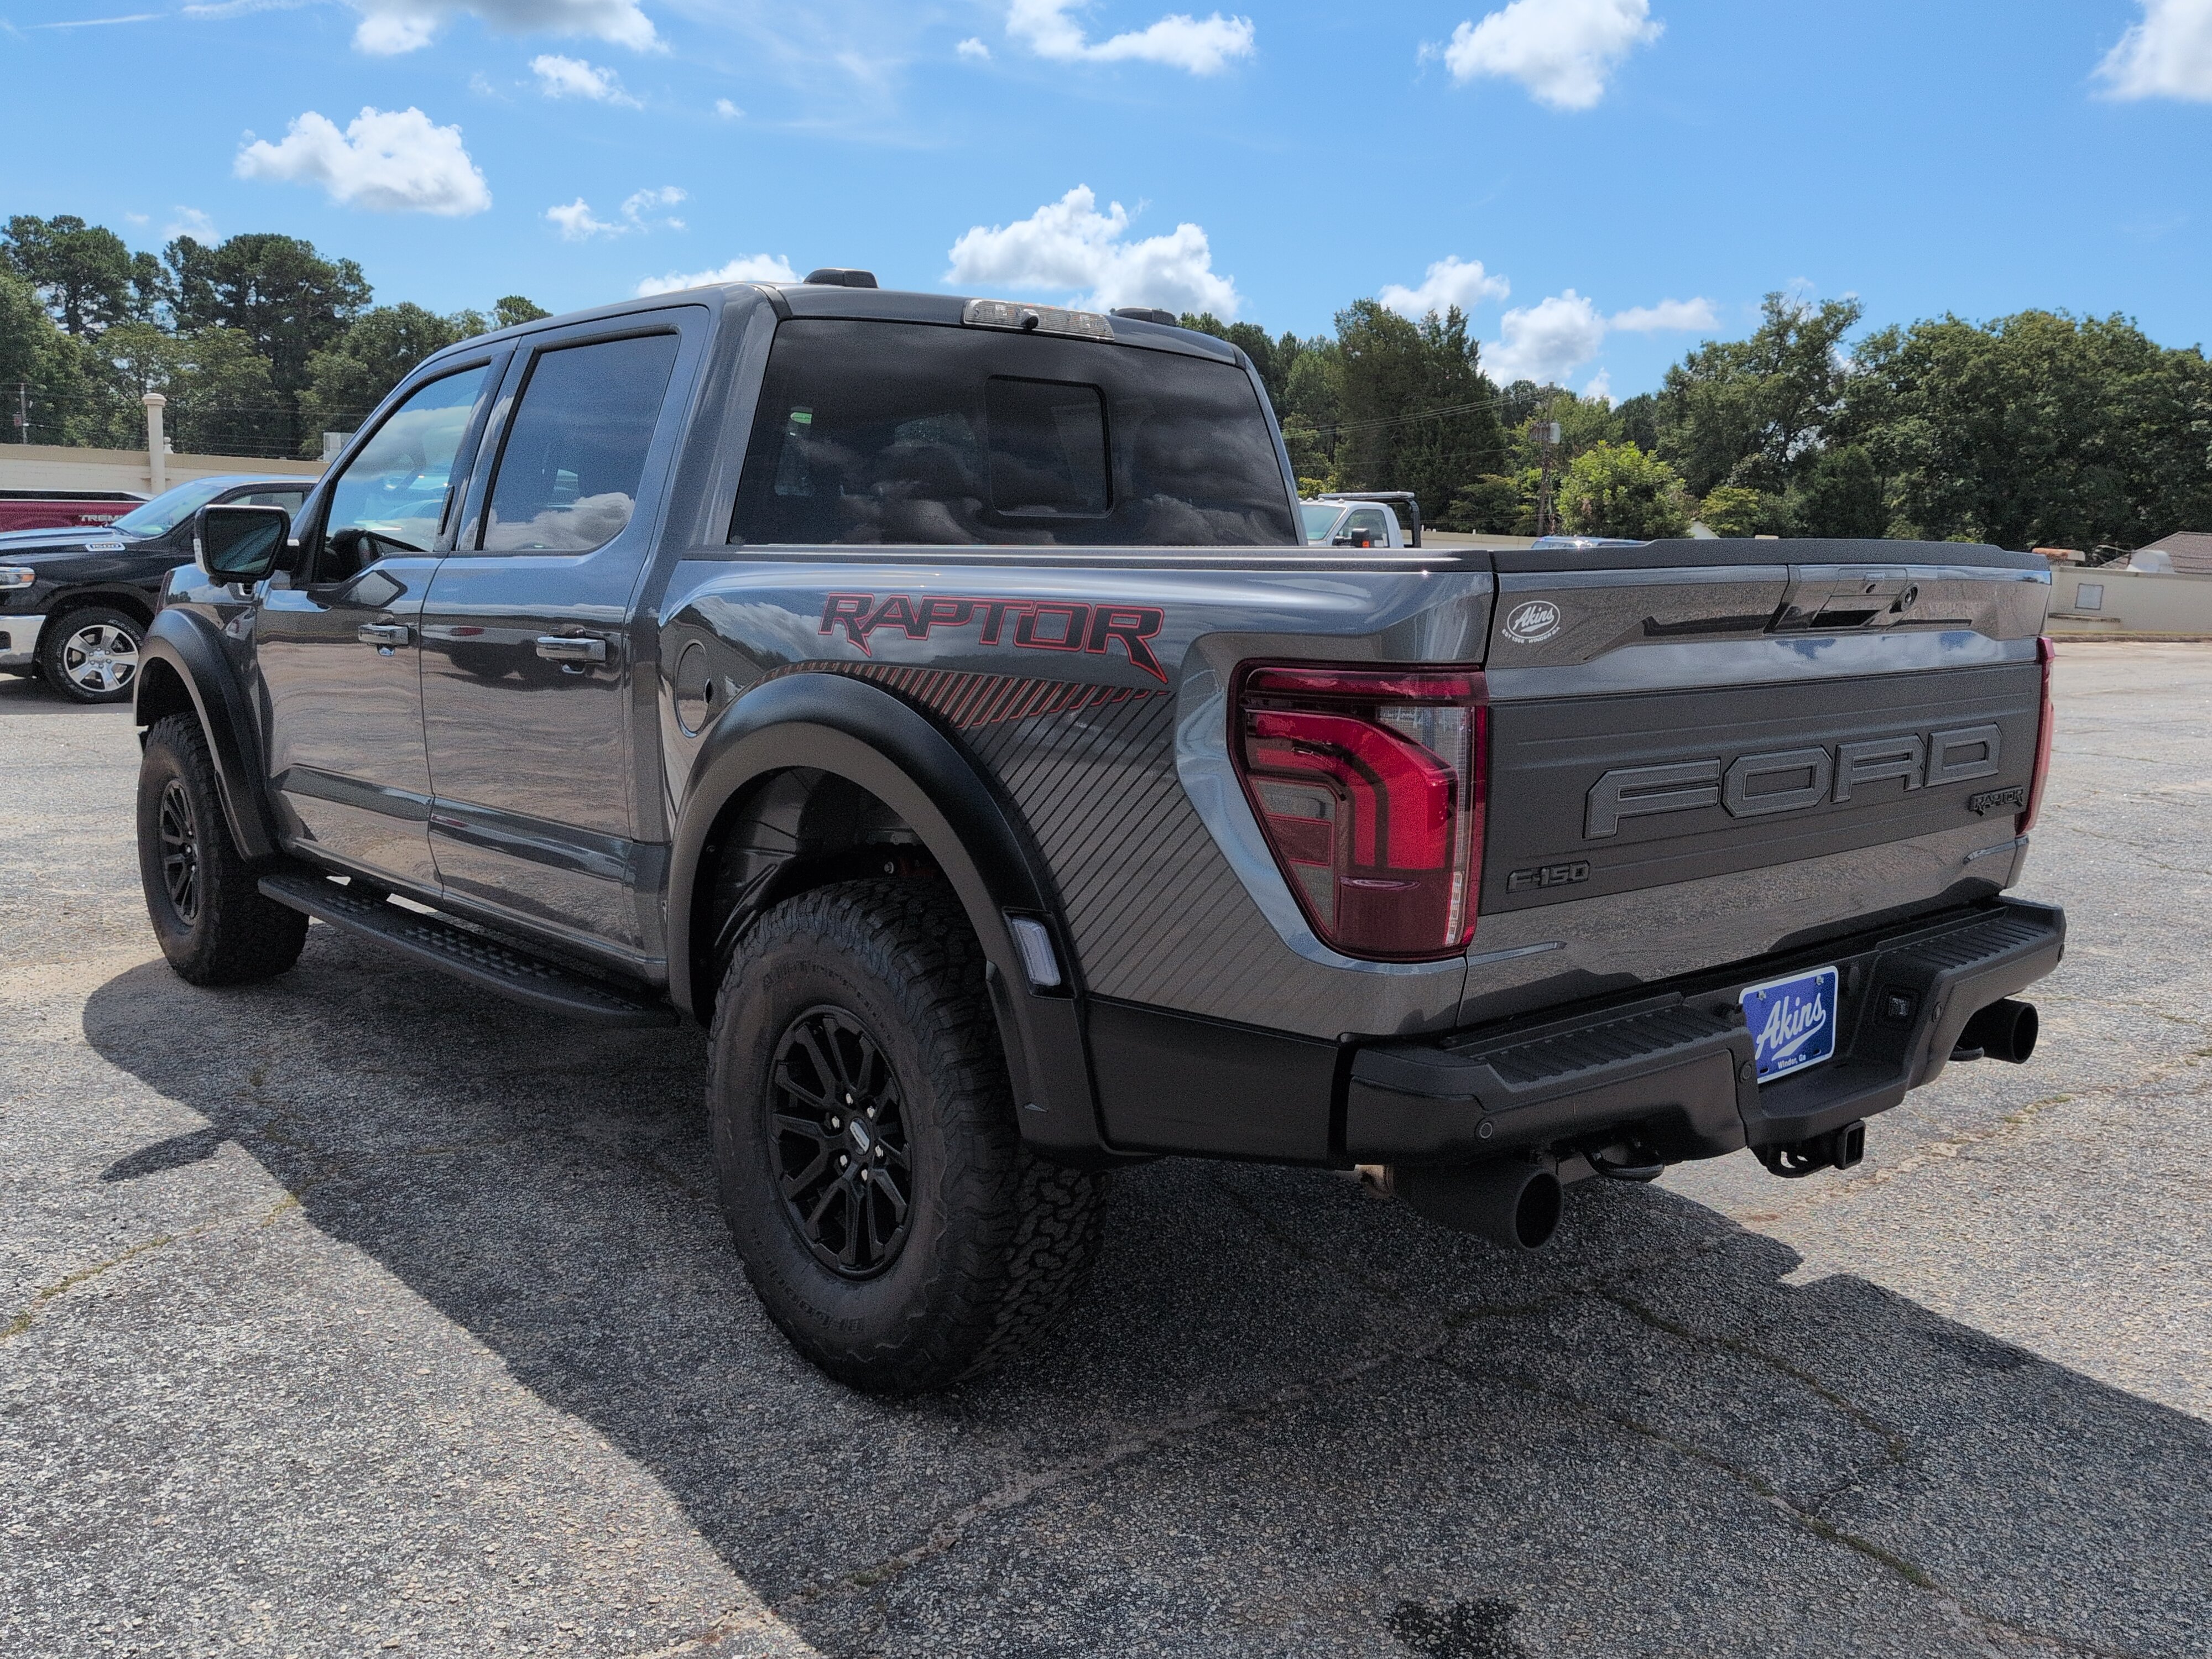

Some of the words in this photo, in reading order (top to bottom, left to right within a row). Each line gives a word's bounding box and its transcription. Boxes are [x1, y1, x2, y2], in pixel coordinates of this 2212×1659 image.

[1512, 606, 1554, 632] Akins
[1528, 633, 1552, 644] WINDER
[1552, 627, 1561, 635] GA
[818, 592, 1168, 684] RAPTOR
[1583, 723, 2002, 840] FORD
[1969, 785, 2023, 816] RAPTOR
[1507, 860, 1589, 893] F-150
[1755, 993, 1826, 1060] Akins
